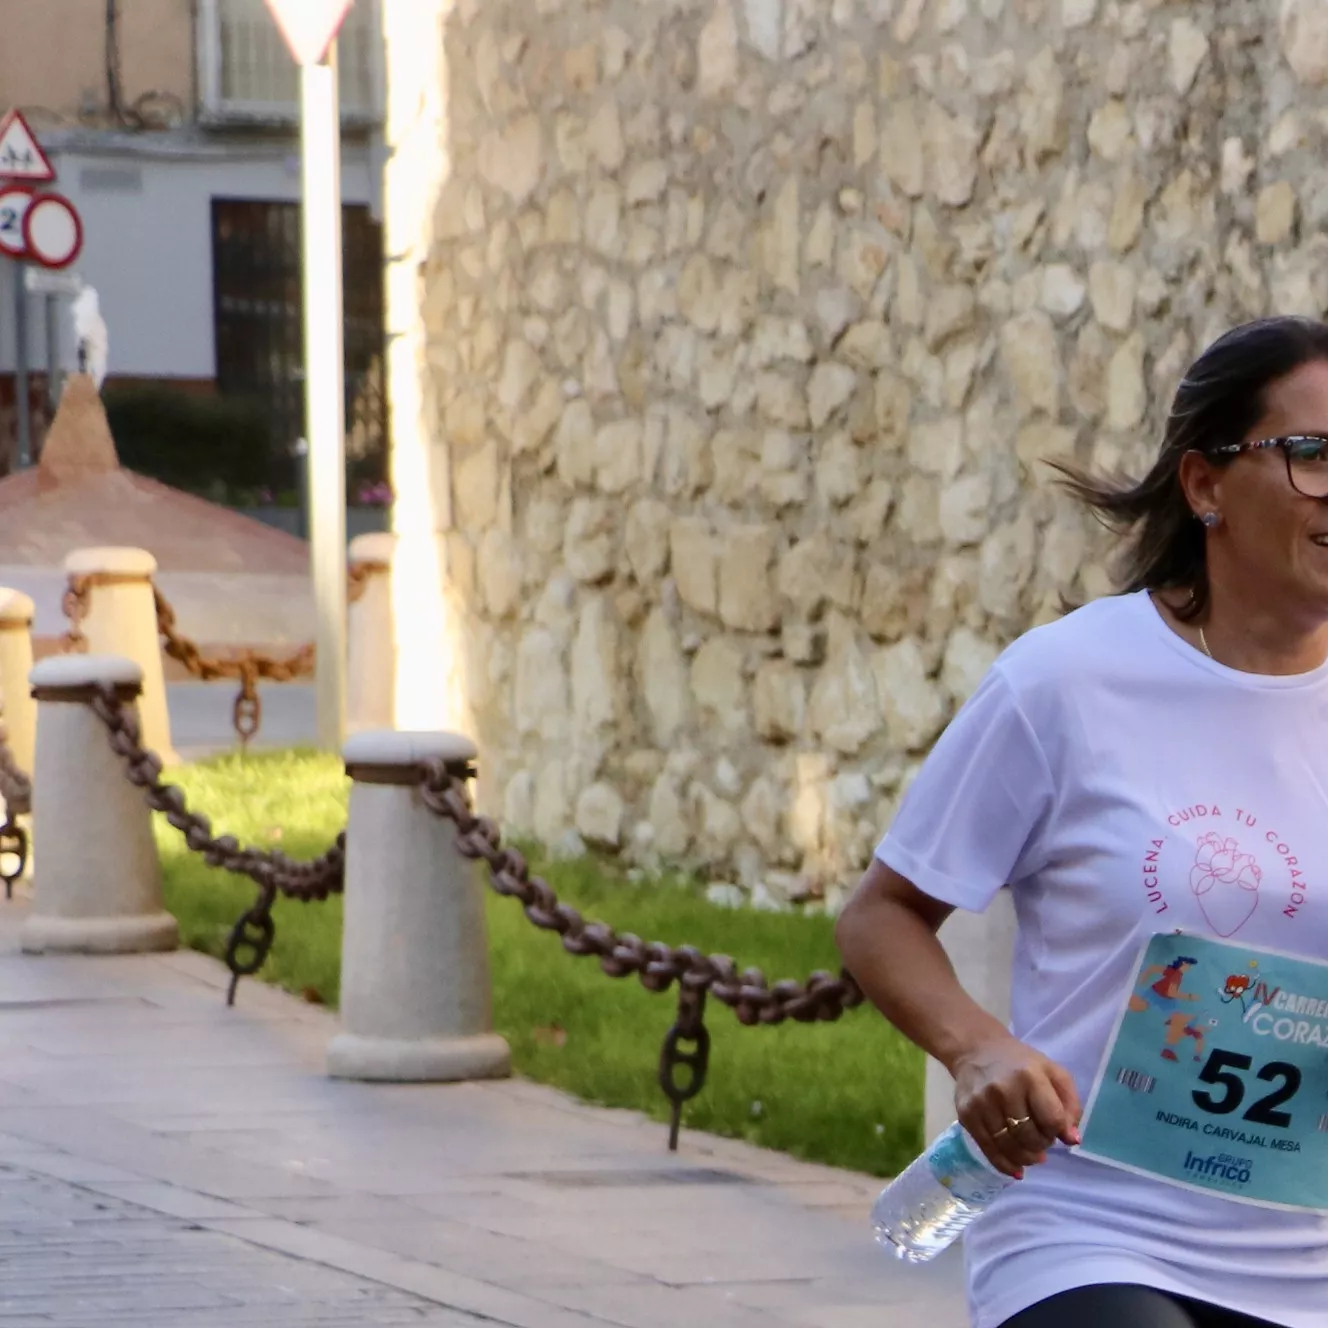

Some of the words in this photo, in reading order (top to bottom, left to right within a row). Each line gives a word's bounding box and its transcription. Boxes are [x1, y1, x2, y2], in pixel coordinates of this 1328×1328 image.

[1168, 804, 1221, 826] CUIDA
[1235, 808, 1257, 827] TU
[1191, 1048, 1302, 1128] 52
[1155, 1110, 1199, 1131] INDIRA
[1203, 1123, 1267, 1147] CARVAJAL
[1270, 1138, 1301, 1153] MESA
[1183, 1150, 1251, 1184] Infrico
